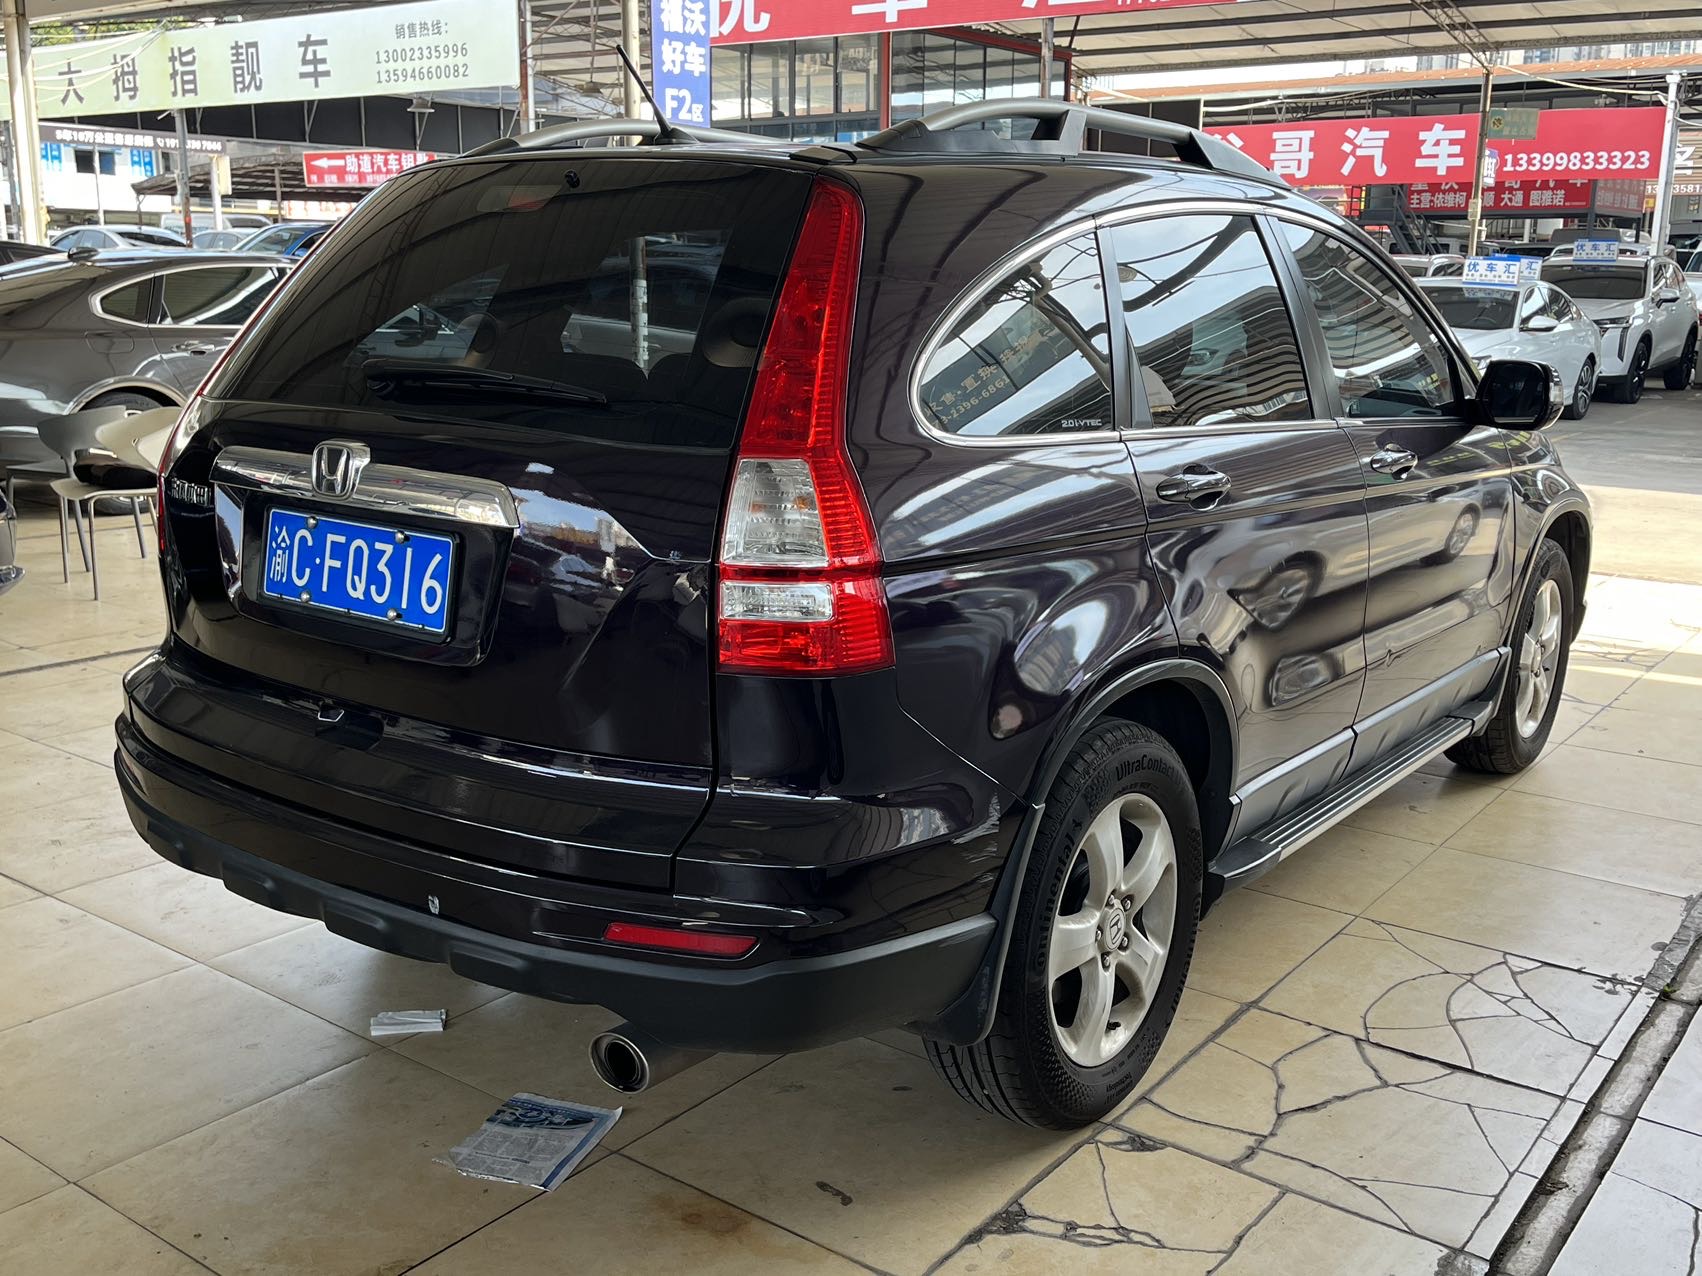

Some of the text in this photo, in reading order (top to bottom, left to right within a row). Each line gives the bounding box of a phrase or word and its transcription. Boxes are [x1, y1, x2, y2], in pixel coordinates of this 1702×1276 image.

[375, 43, 469, 65] 13002335996
[661, 38, 706, 77] 好车
[58, 33, 332, 106] 大拇指靓车
[376, 63, 470, 84] 13594660082
[665, 88, 704, 122] F2区
[1213, 122, 1466, 179] 哥汽车
[1502, 150, 1650, 172] 13399833323
[1467, 261, 1517, 275] 优车汇
